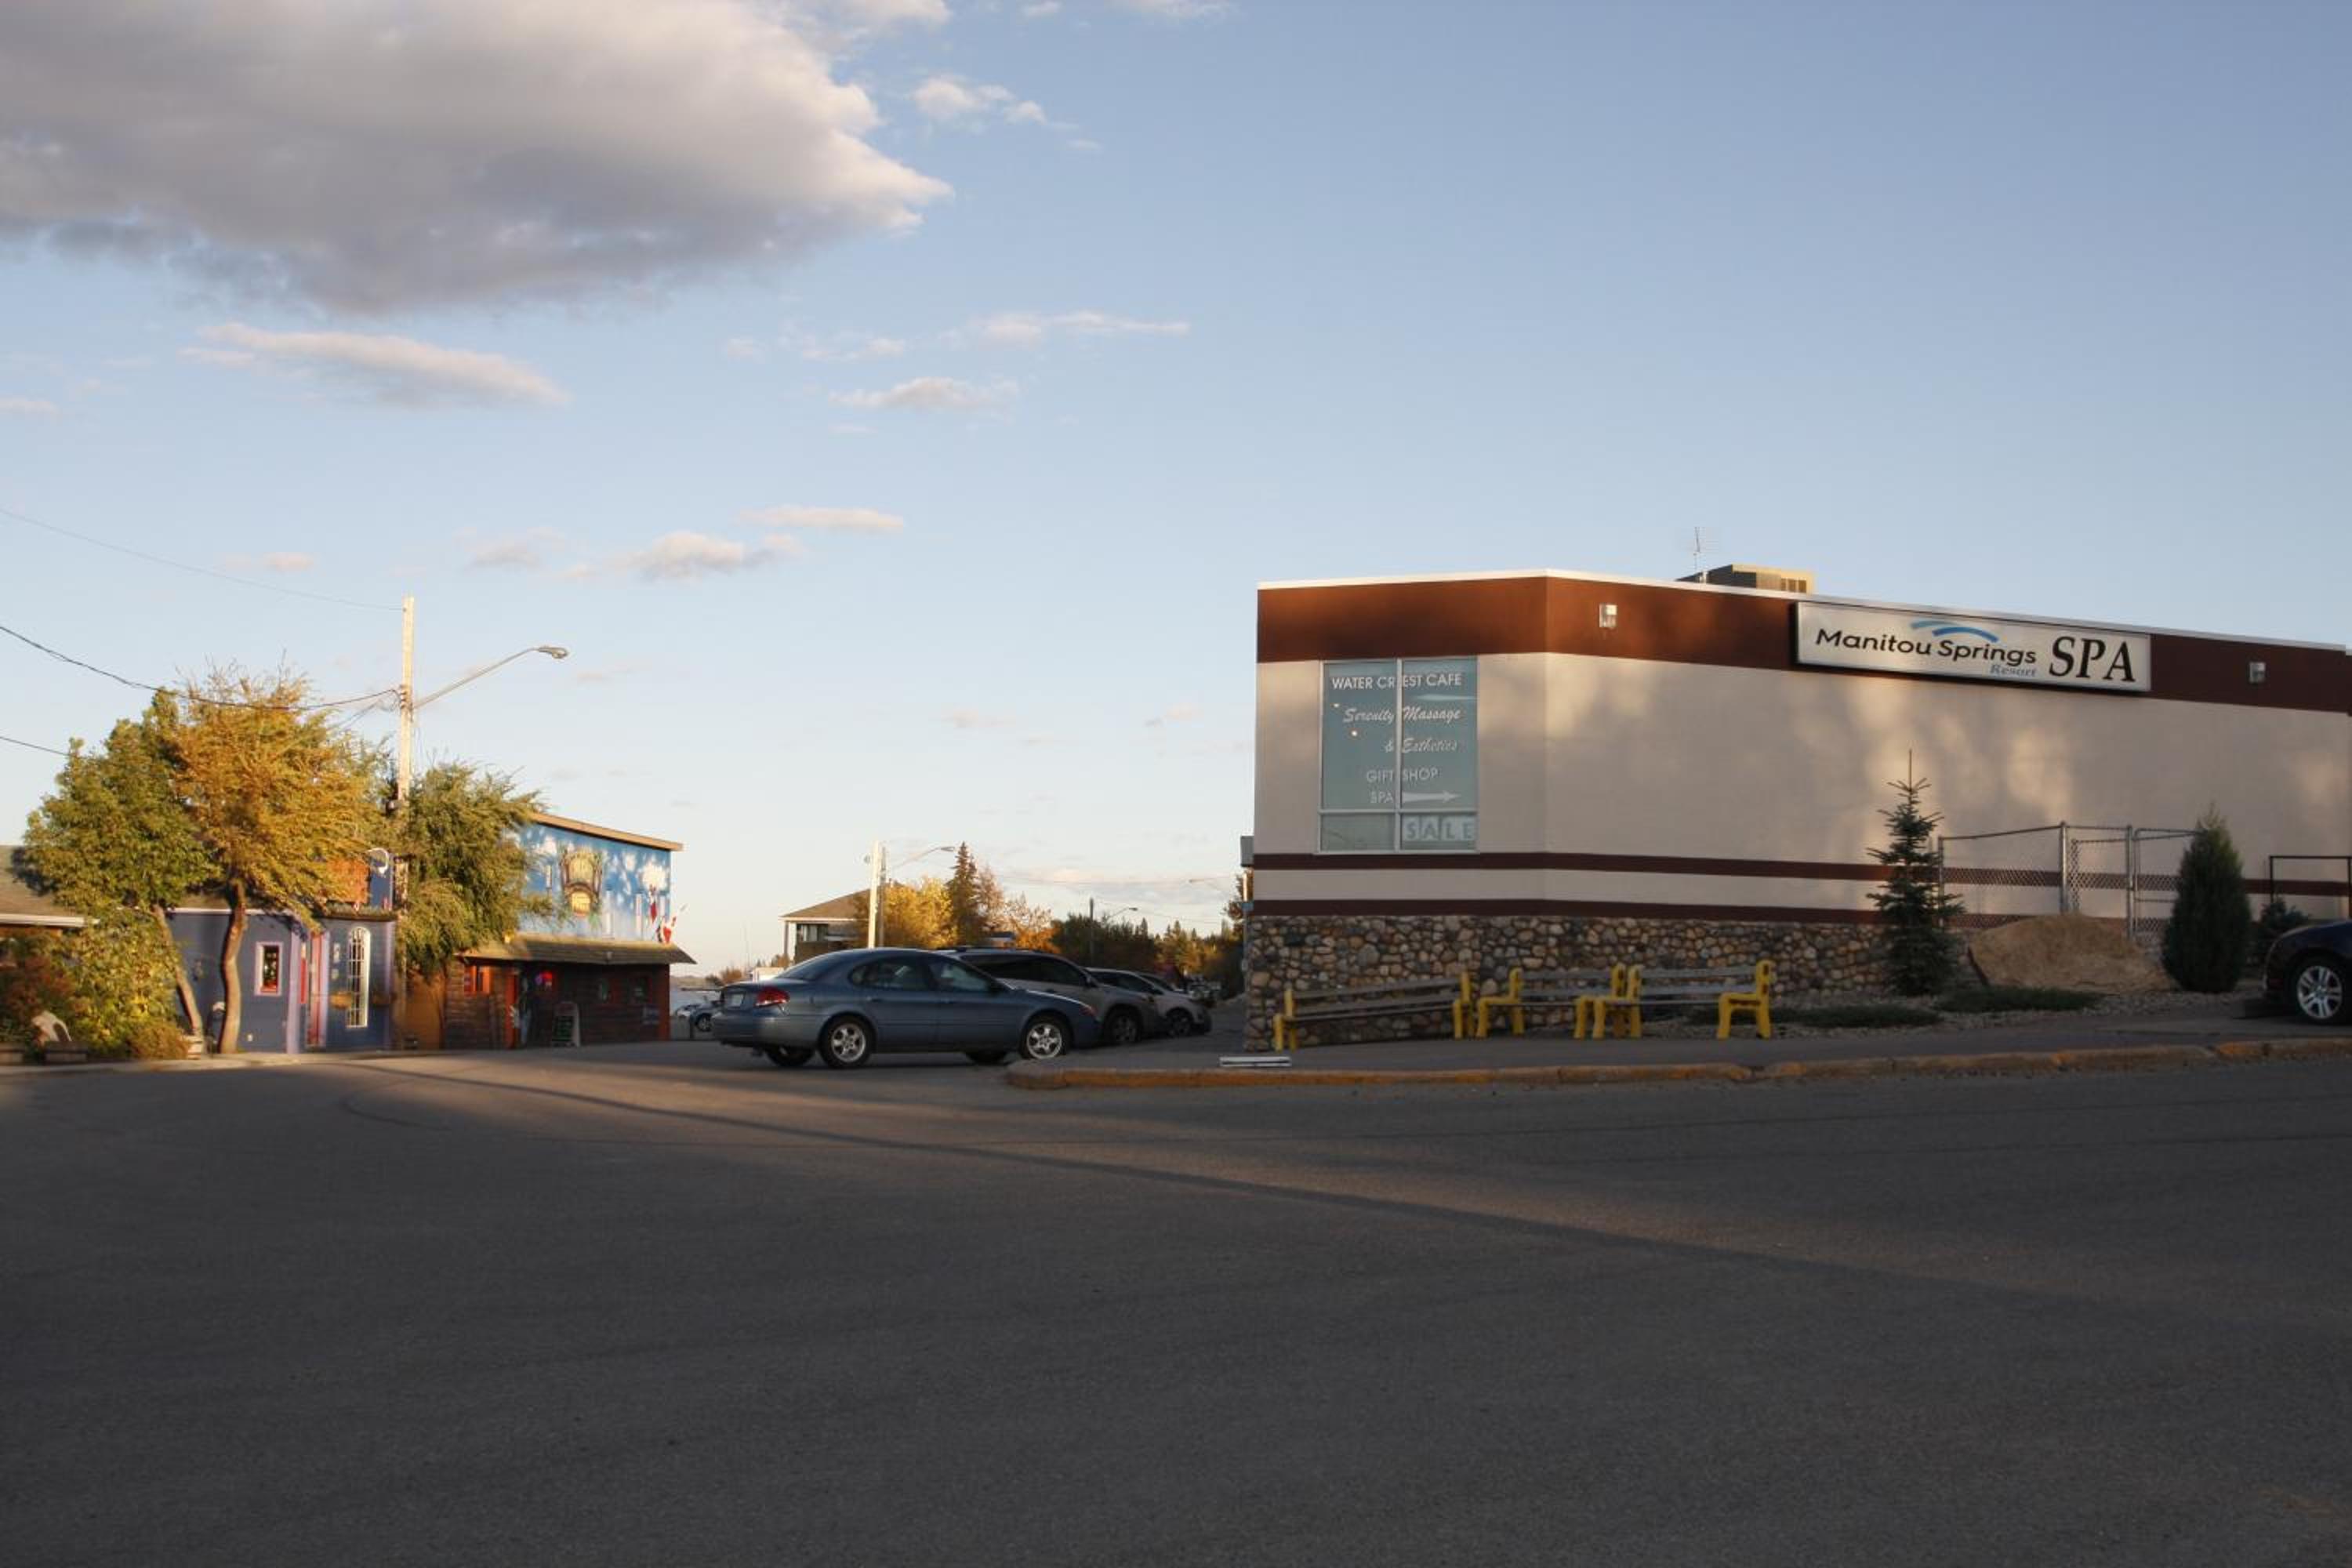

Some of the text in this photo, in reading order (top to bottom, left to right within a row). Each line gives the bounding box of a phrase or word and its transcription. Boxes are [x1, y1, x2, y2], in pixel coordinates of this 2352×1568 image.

[1815, 628, 2136, 683] Manitou Springs SPA
[1990, 662, 2037, 679] Resort
[1332, 677, 1374, 690] WATER
[1426, 673, 1463, 687] CAFE
[1402, 706, 1461, 724] Massage
[1366, 768, 1439, 784] GIFT SHOP
[1370, 791, 1394, 804] SPA
[1406, 820, 1475, 840] SALE
